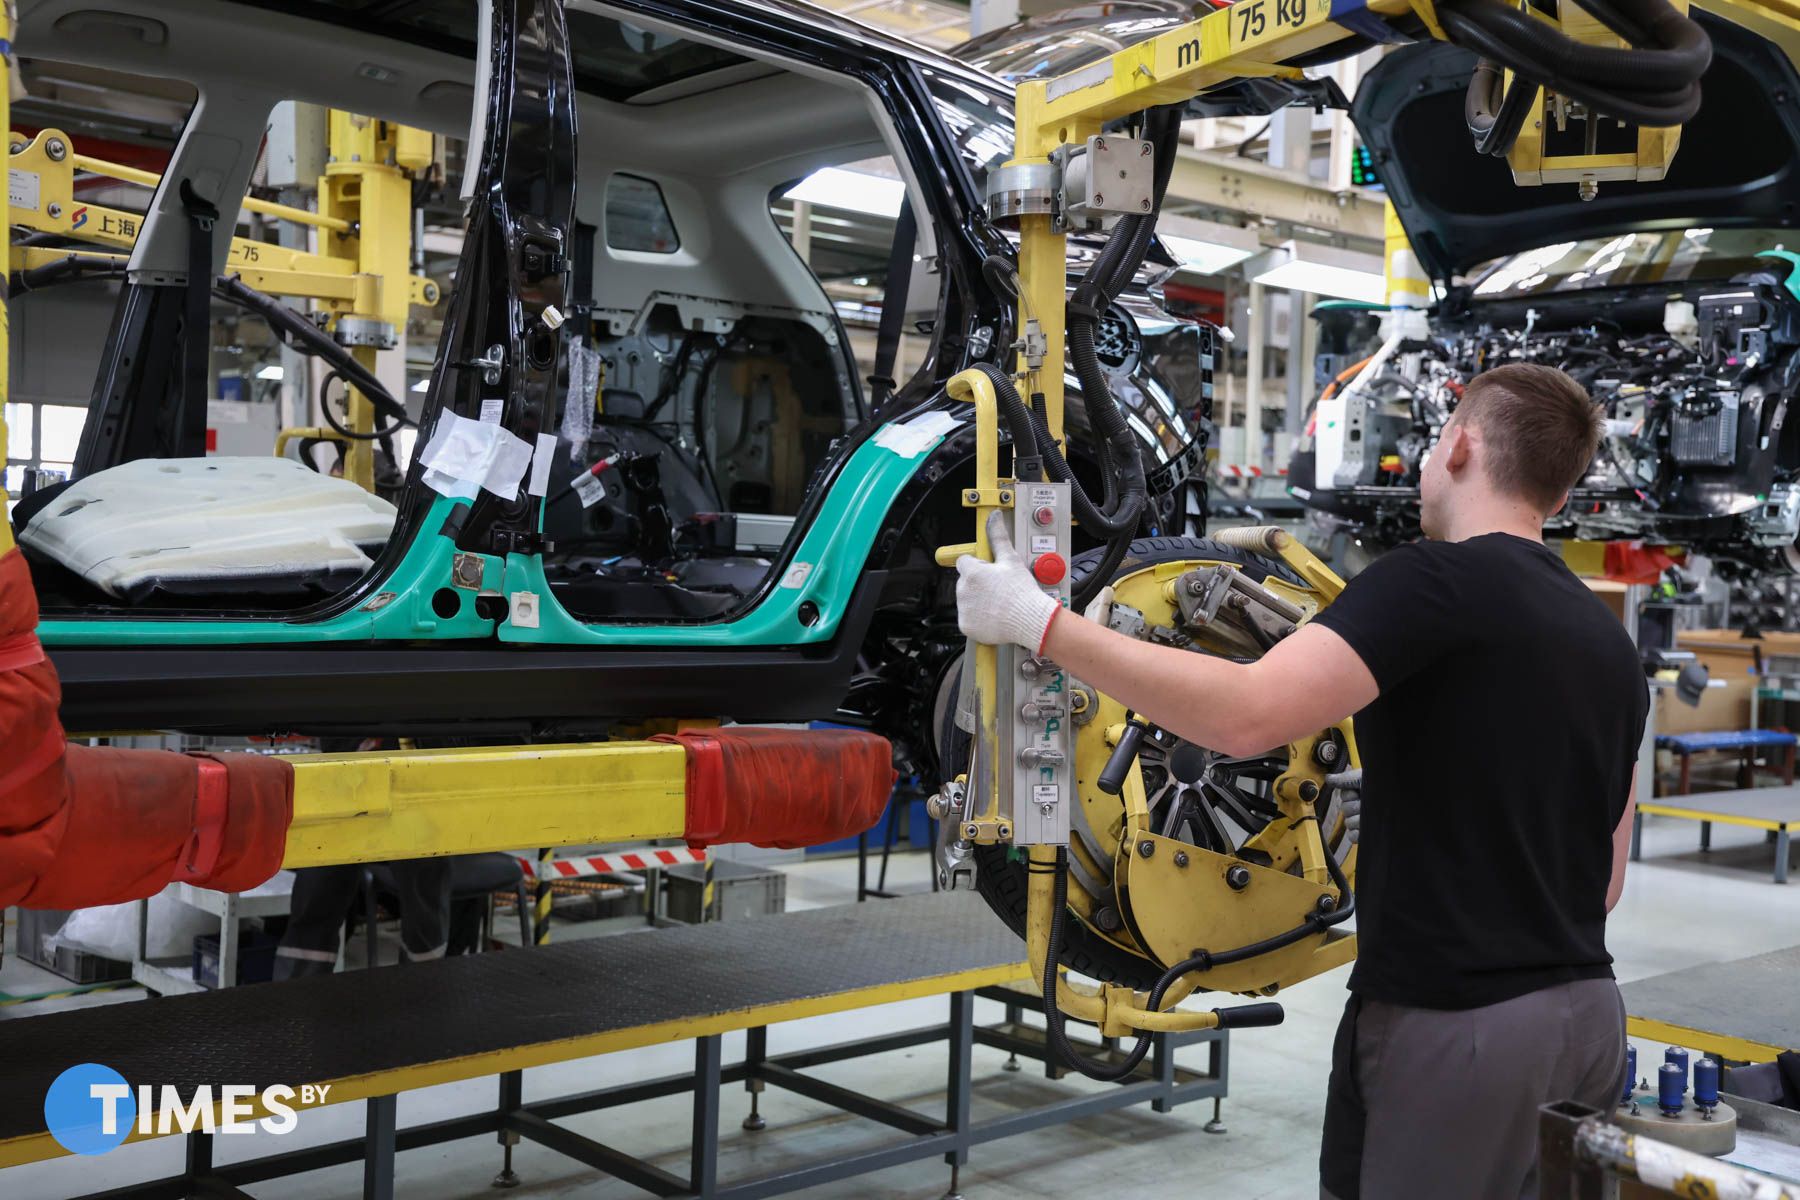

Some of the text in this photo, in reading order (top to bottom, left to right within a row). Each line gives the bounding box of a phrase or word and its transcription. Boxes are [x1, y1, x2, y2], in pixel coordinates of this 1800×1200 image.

[1238, 1, 1266, 42] 75
[1277, 0, 1306, 27] kg
[98, 215, 136, 238] 上海
